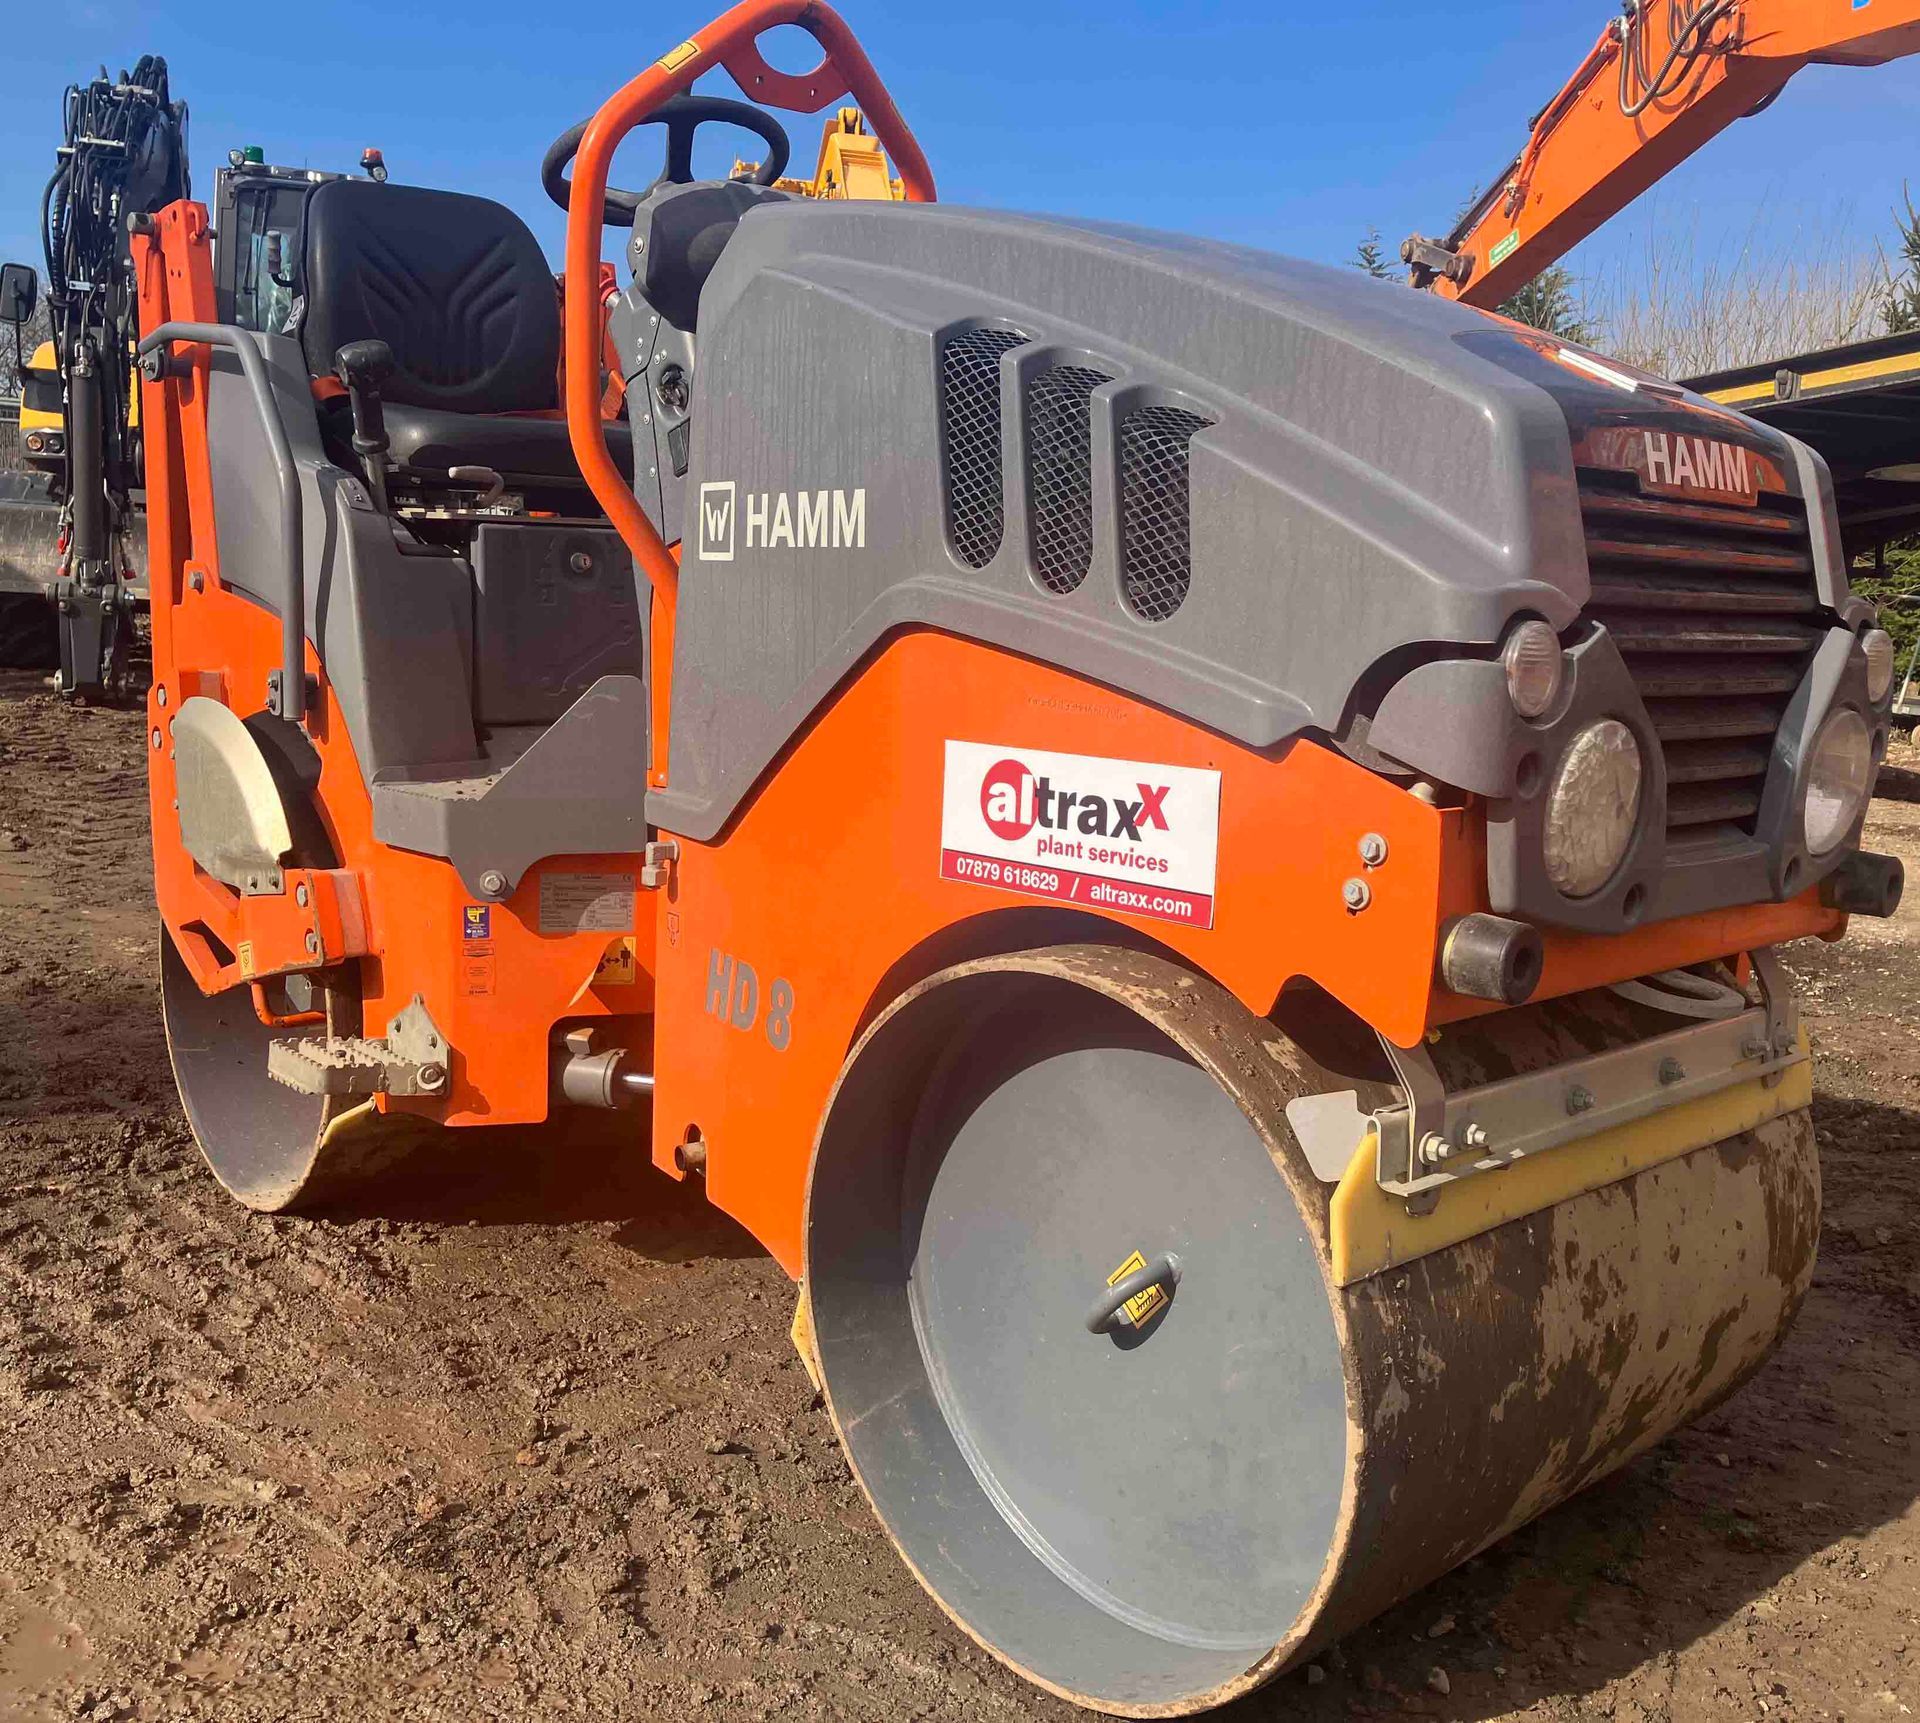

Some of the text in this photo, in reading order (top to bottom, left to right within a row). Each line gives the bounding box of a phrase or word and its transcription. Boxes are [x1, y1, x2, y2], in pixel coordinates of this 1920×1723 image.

[1644, 431, 1750, 494] HAMM
[746, 488, 866, 548] HAMM
[1037, 835, 1169, 873] plant services
[956, 857, 1001, 880] 07879
[1003, 865, 1059, 892] 618629
[1090, 882, 1192, 917] altraxx.com
[705, 947, 793, 1051] HD 8
